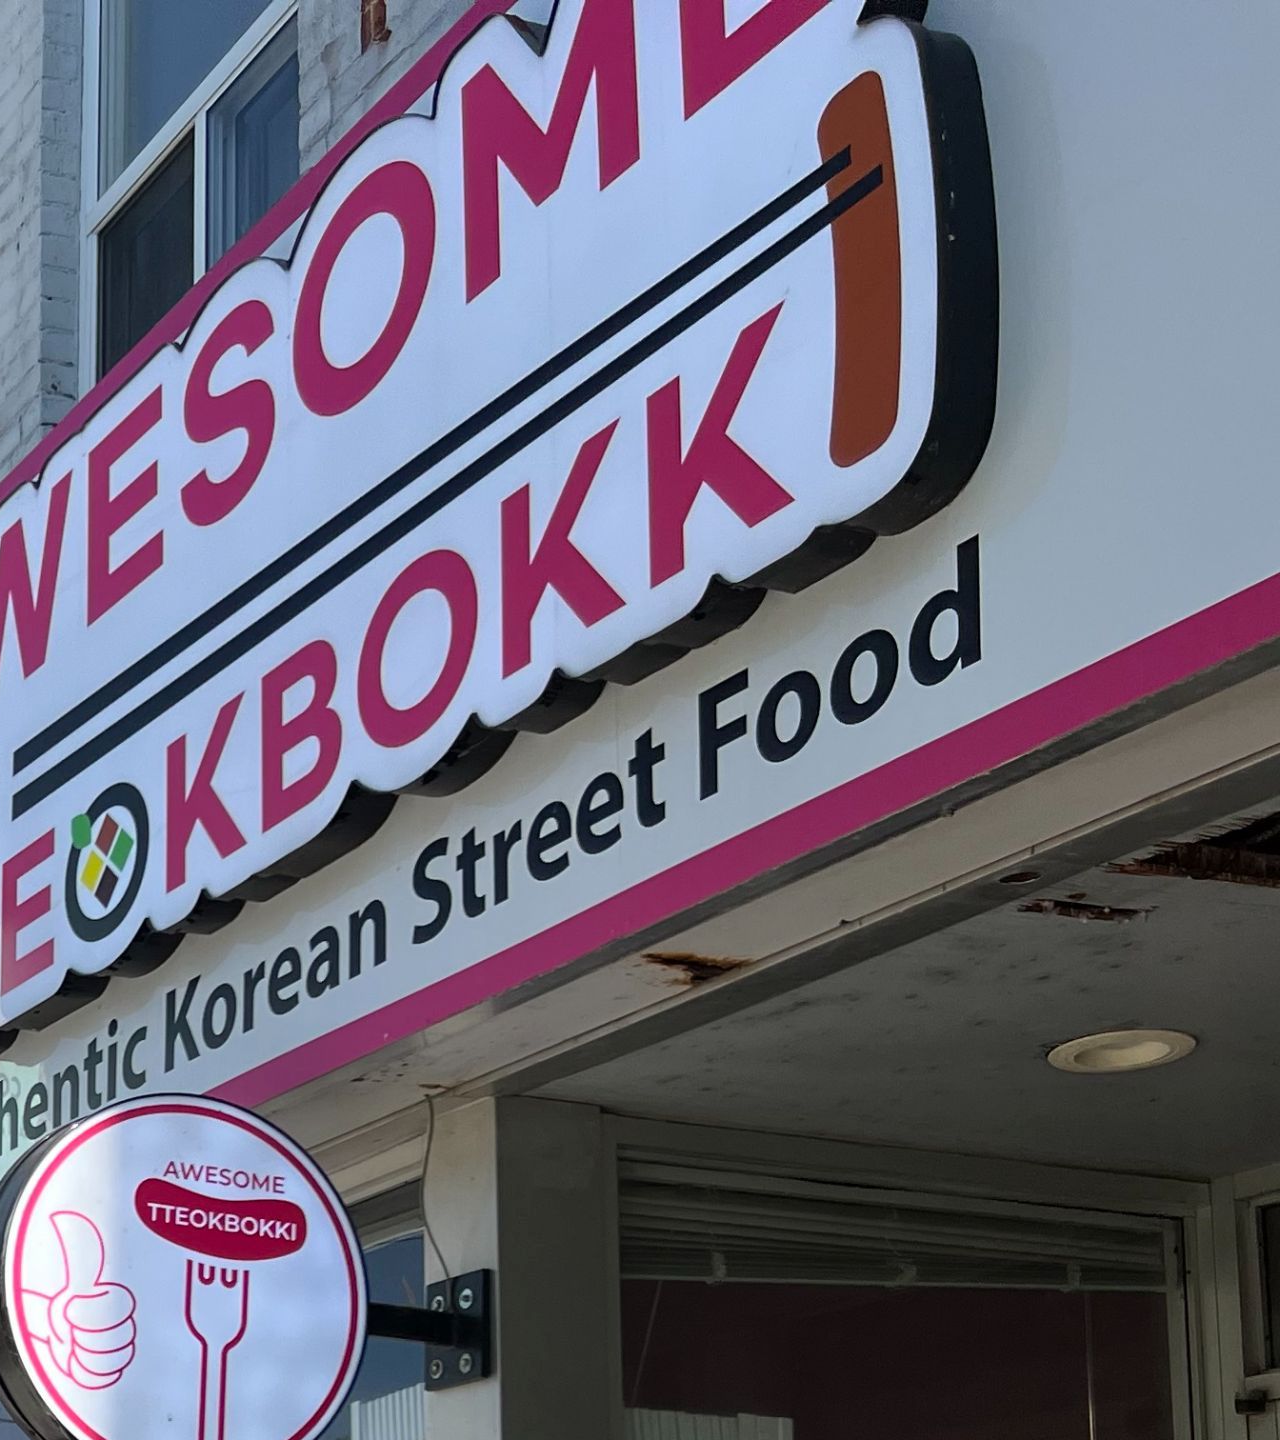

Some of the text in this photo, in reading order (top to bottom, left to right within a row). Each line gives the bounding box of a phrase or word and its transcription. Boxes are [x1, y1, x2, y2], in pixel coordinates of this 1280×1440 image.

[163, 899, 387, 1072] Korean
[411, 734, 666, 944] Street
[699, 534, 982, 800] Food
[163, 1161, 286, 1194] AWESOME
[147, 1202, 297, 1241] TTEOKBOKKI
